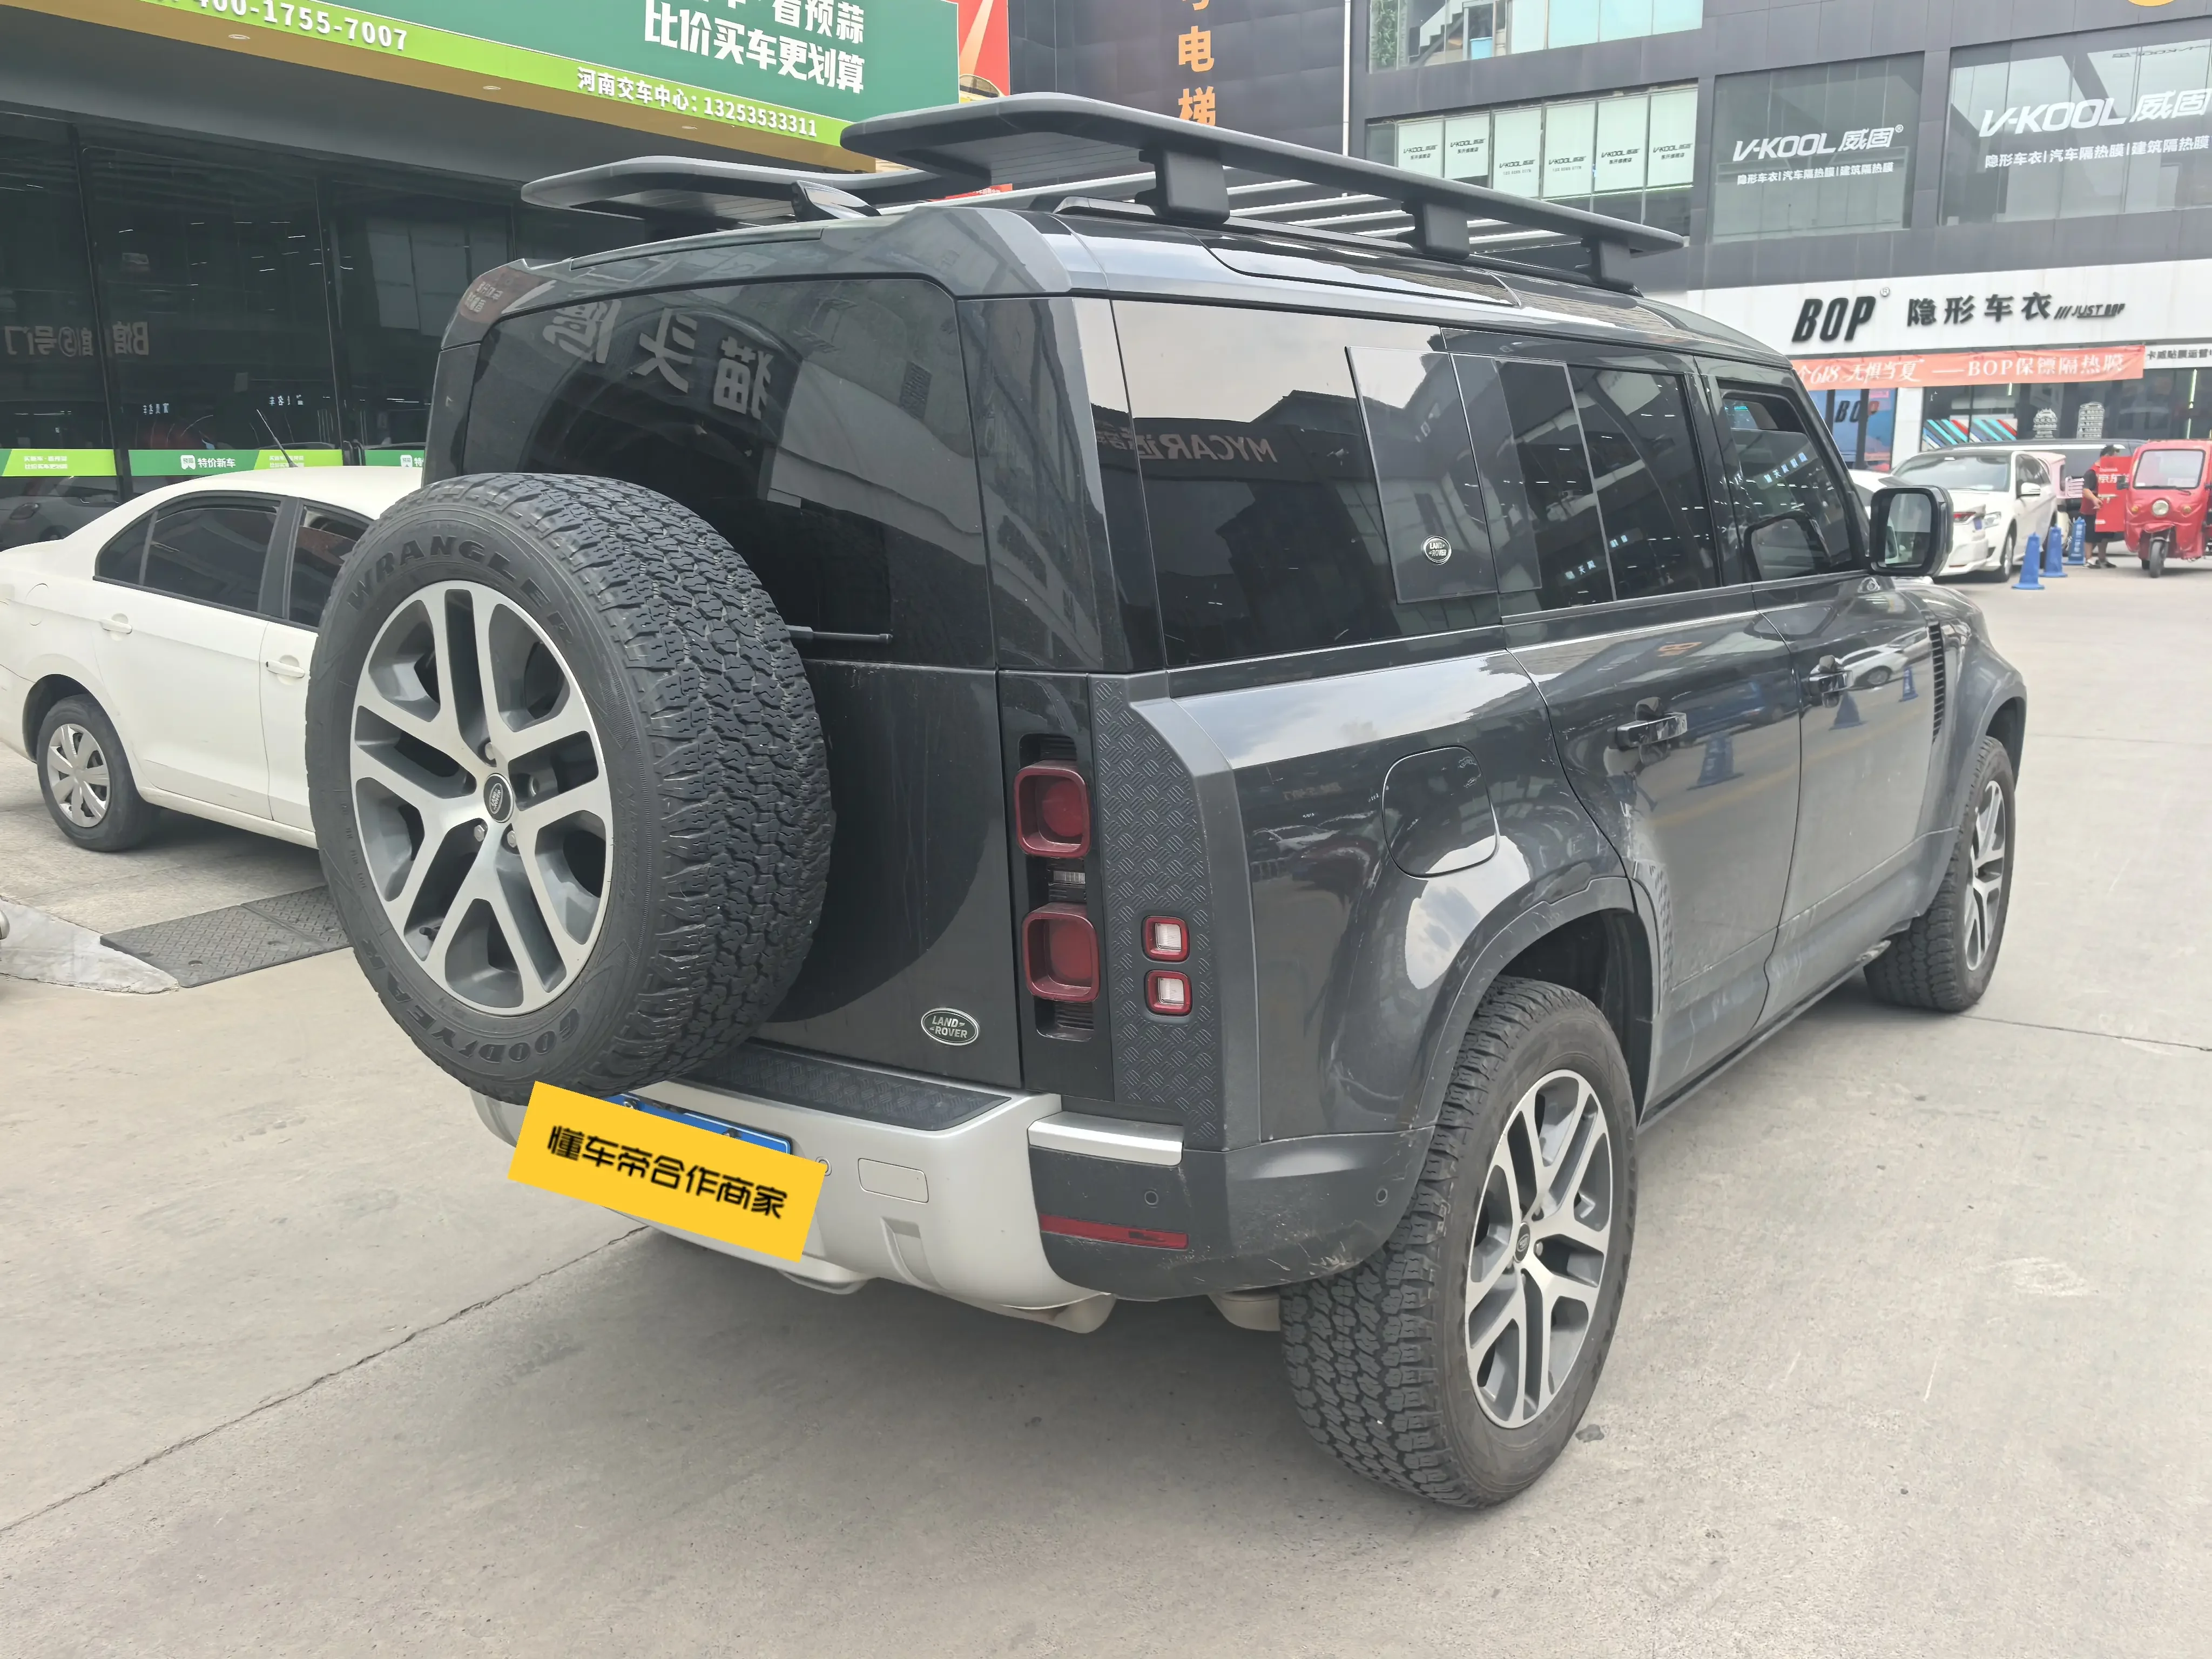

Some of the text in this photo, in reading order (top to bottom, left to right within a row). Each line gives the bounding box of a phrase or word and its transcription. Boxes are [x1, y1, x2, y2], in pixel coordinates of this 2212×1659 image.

[644, 1, 865, 94] 比价买车更划算
[1979, 98, 2127, 137] V-KOOL
[1732, 133, 1836, 161] V-KOOL
[1792, 296, 1876, 342] BOP
[1907, 292, 2053, 327] 隐形车衣
[2072, 304, 2103, 316] JUST
[197, 457, 236, 468] 特价新车
[347, 535, 574, 644] WRANGLER
[361, 938, 581, 1063] GOODYEAR
[932, 1015, 959, 1027] LAND
[935, 1026, 968, 1038] ROVER
